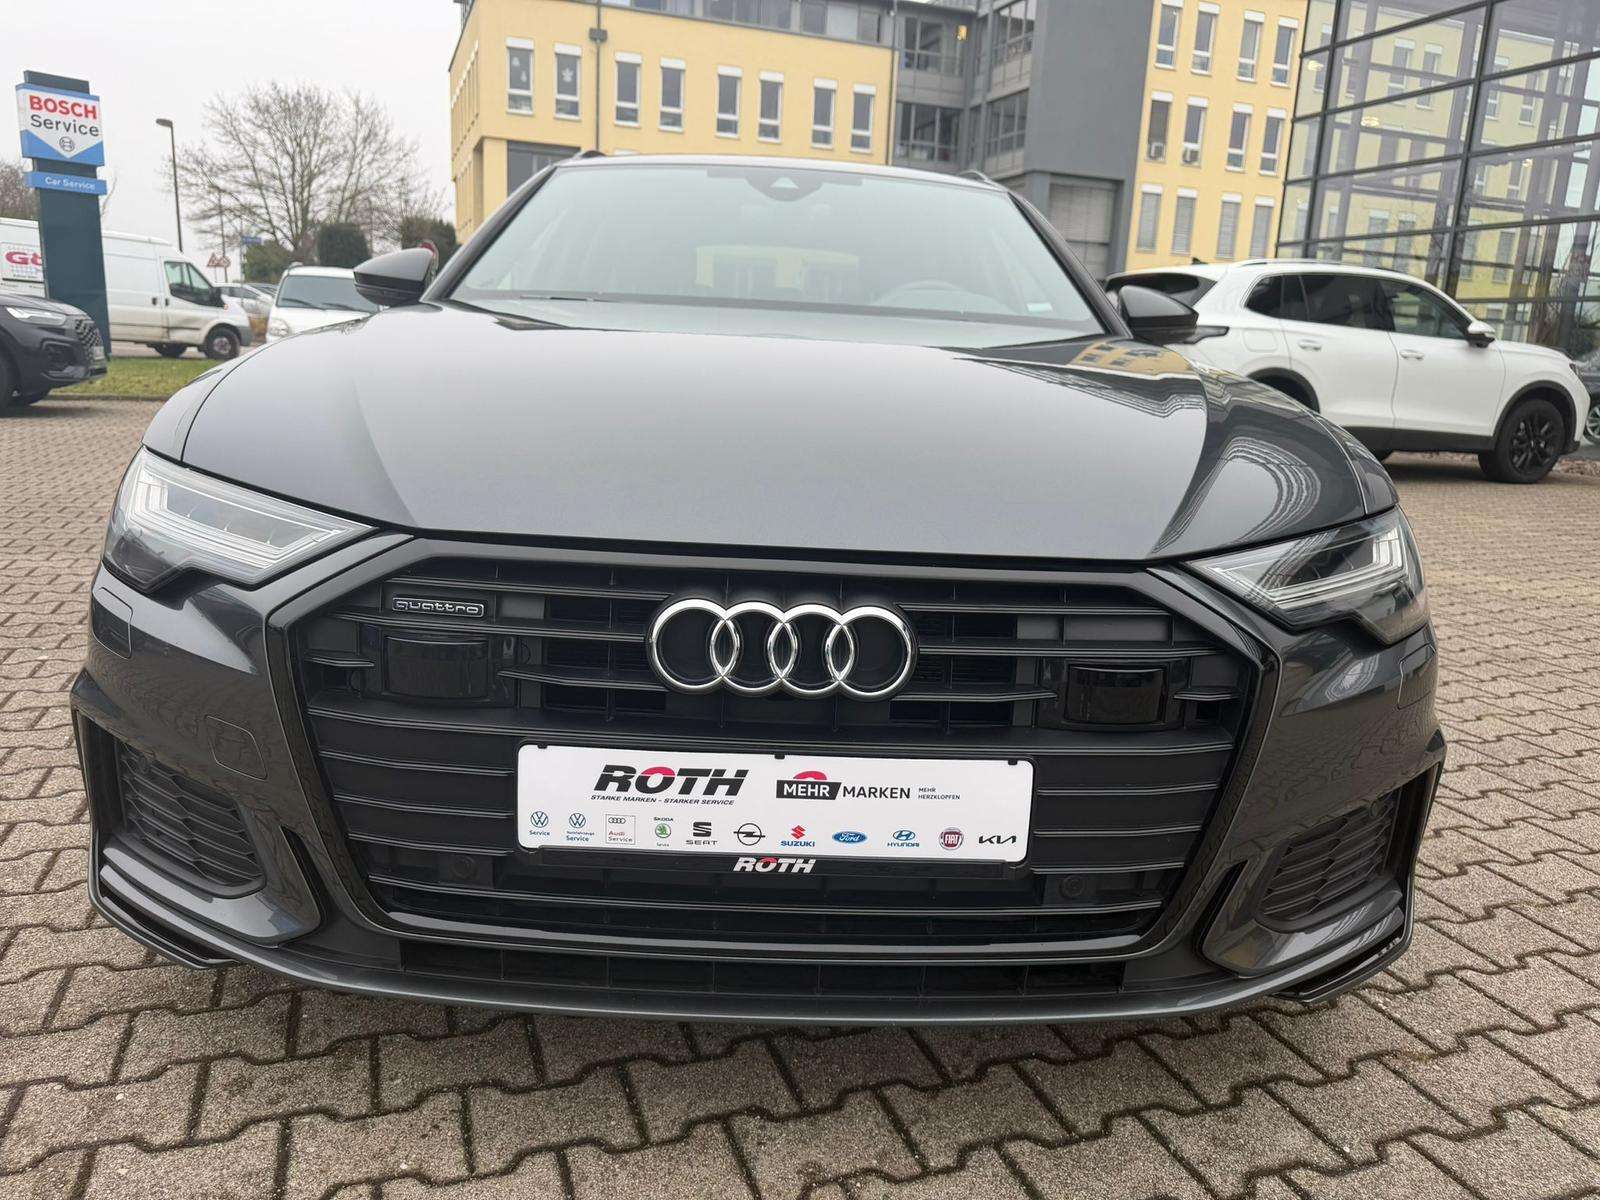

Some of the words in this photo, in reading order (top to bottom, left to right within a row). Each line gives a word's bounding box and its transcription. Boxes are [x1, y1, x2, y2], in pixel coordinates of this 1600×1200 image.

[29, 95, 97, 119] BOSCH
[30, 114, 99, 137] Service
[45, 176, 62, 185] Car
[62, 178, 96, 190] Service
[396, 600, 479, 614] quattro
[593, 764, 749, 797] ROTH
[783, 783, 830, 797] MEHR
[843, 785, 911, 799] MARKEN
[918, 793, 961, 801] HERZKLOPFEN
[591, 794, 621, 802] STARKE
[623, 795, 656, 803] MARKEN
[663, 797, 700, 805] STARKER
[944, 834, 959, 845] FIAT
[733, 856, 817, 874] ROTH
